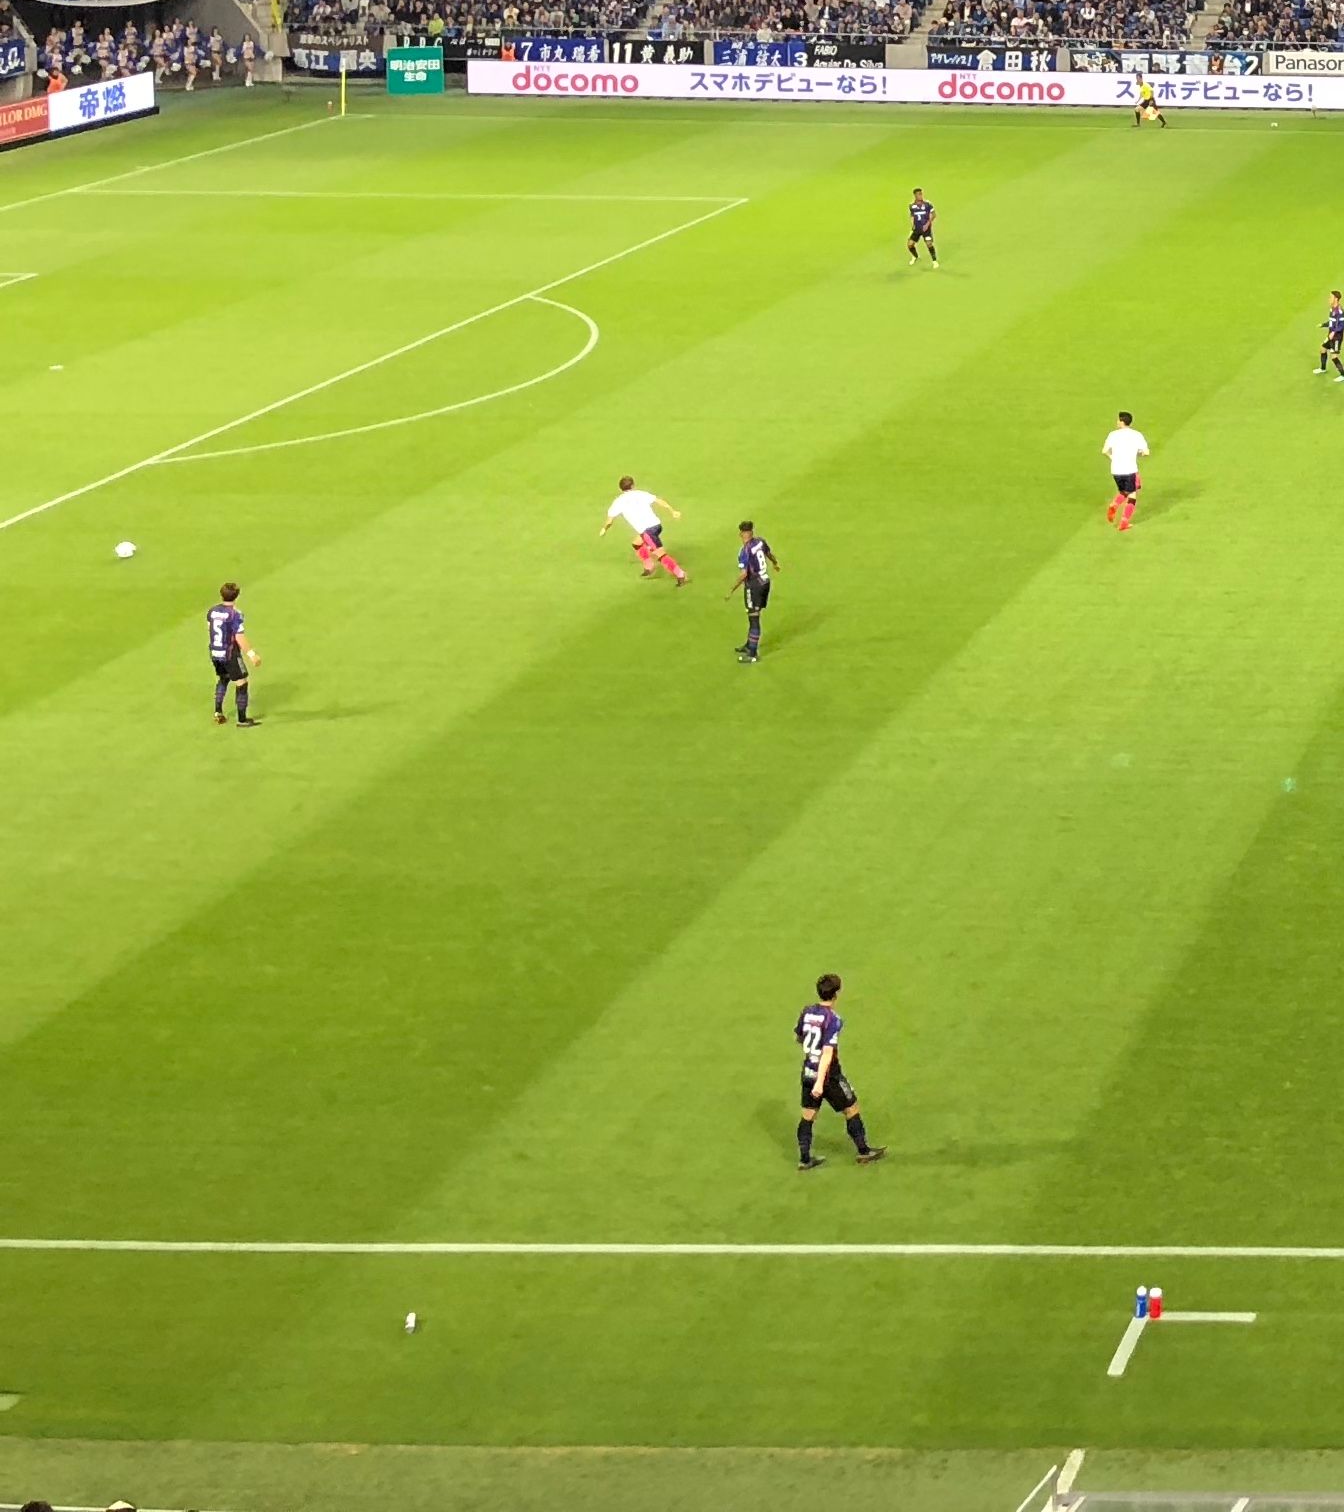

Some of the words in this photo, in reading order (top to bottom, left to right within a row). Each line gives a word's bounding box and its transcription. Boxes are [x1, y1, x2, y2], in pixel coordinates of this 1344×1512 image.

[539, 45, 567, 62] 市丸
[612, 42, 634, 63] 11
[640, 45, 655, 64] 黄
[721, 50, 748, 67] 三浦
[794, 52, 808, 66] 3
[404, 71, 427, 82] 生命
[512, 65, 639, 93] docomo
[691, 72, 886, 94] スマホデビューなら!
[938, 74, 1065, 101] docomo
[25, 104, 47, 119] DMG
[213, 619, 223, 647] 5
[803, 1025, 823, 1054] 22
